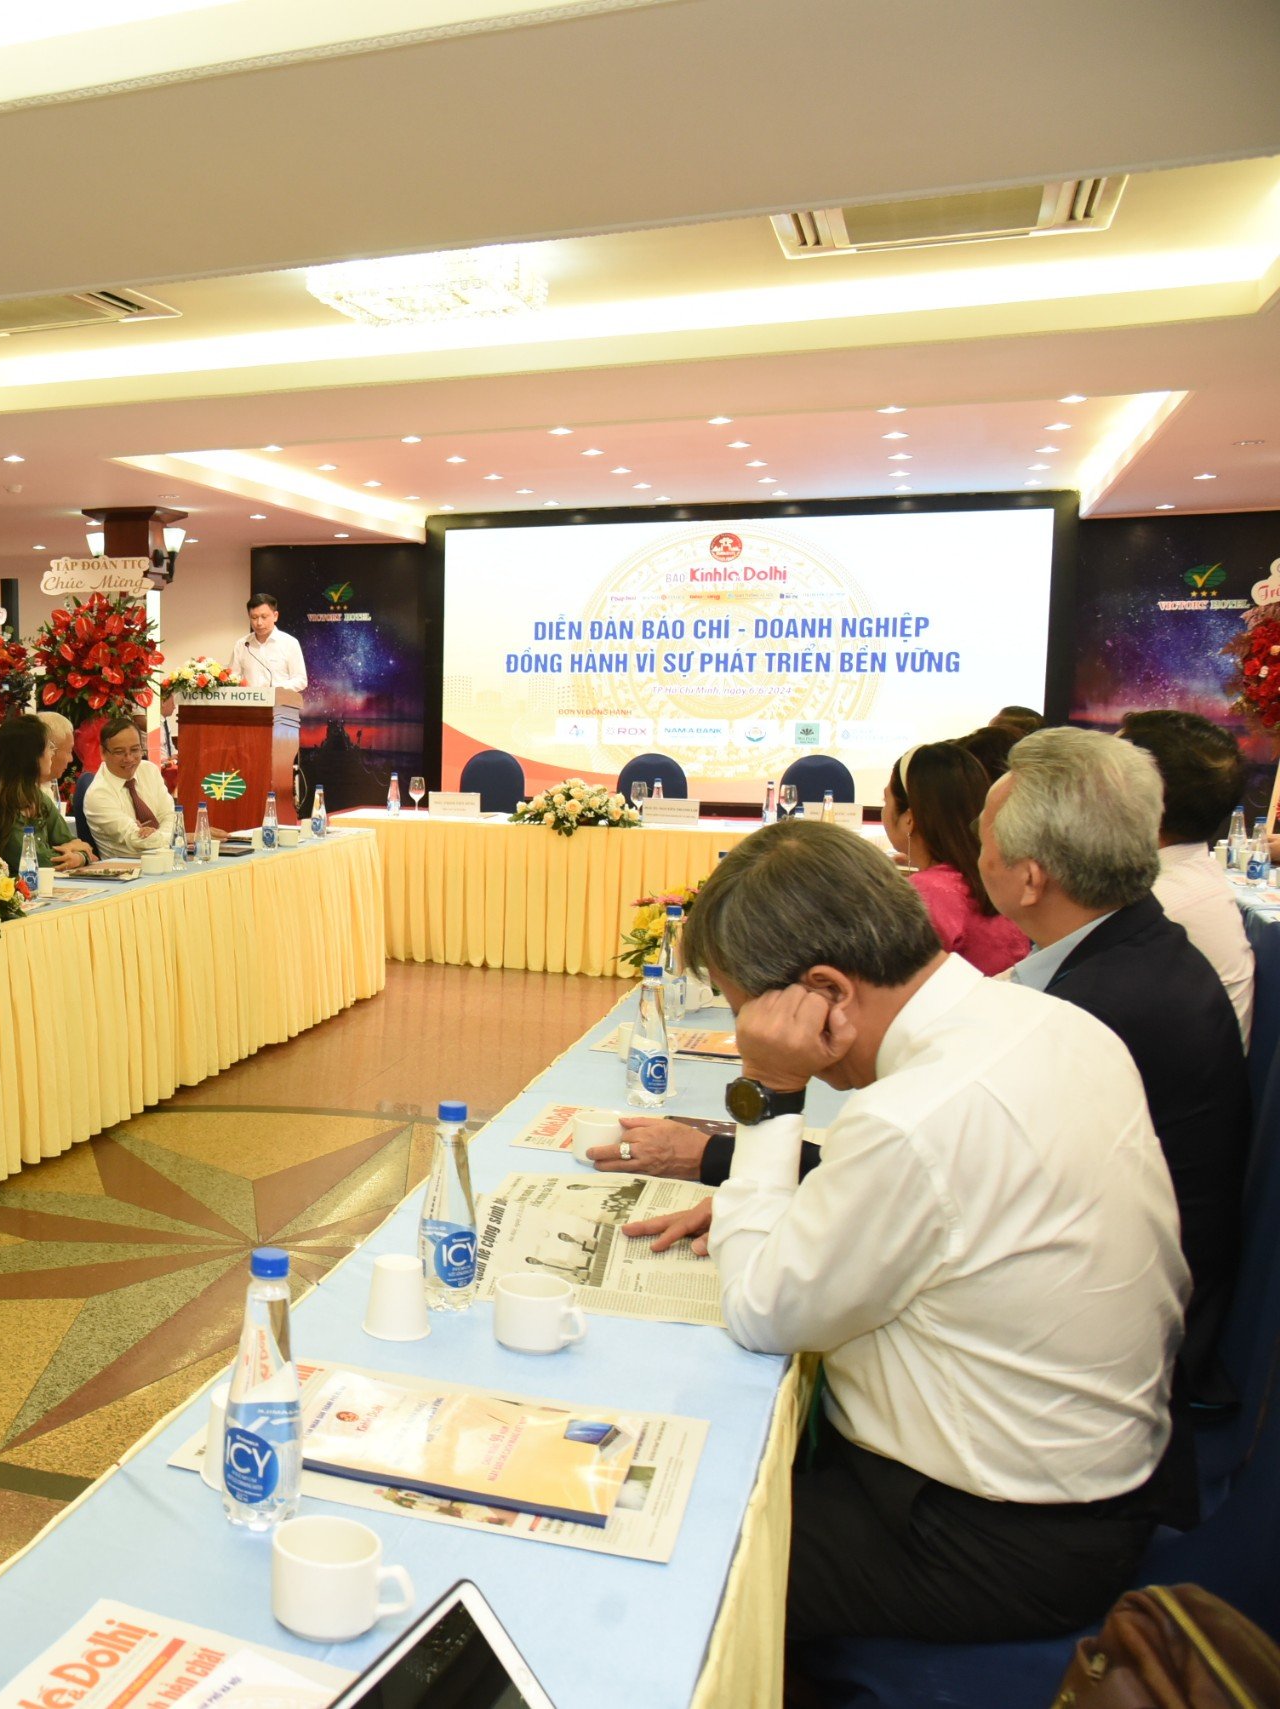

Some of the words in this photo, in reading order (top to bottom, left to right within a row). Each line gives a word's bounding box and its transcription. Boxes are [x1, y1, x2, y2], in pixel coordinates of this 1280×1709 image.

[81, 556, 117, 570] ĐOÀN
[122, 559, 146, 570] TTC
[44, 576, 86, 591] Chúc
[534, 614, 582, 640] DIỄN
[590, 616, 634, 640] ĐÀN
[642, 615, 685, 640] BÁO
[693, 614, 730, 640] CHÍ
[754, 617, 832, 639] DOANH
[841, 612, 930, 643] NGHIỆP
[506, 647, 563, 673] ĐỒNG
[570, 649, 628, 673] HÀNH
[636, 649, 656, 673] VÌ
[663, 650, 694, 677] SỰ
[700, 648, 757, 673] PHÁT
[765, 643, 832, 673] TRIỂN
[839, 644, 887, 673] BỀN
[895, 647, 960, 673] VỮNG
[182, 691, 228, 701] VICTORY
[231, 692, 266, 701] HOTEL
[617, 728, 647, 736] ROX
[442, 1241, 477, 1267] ICY
[226, 1435, 272, 1479] ICY
